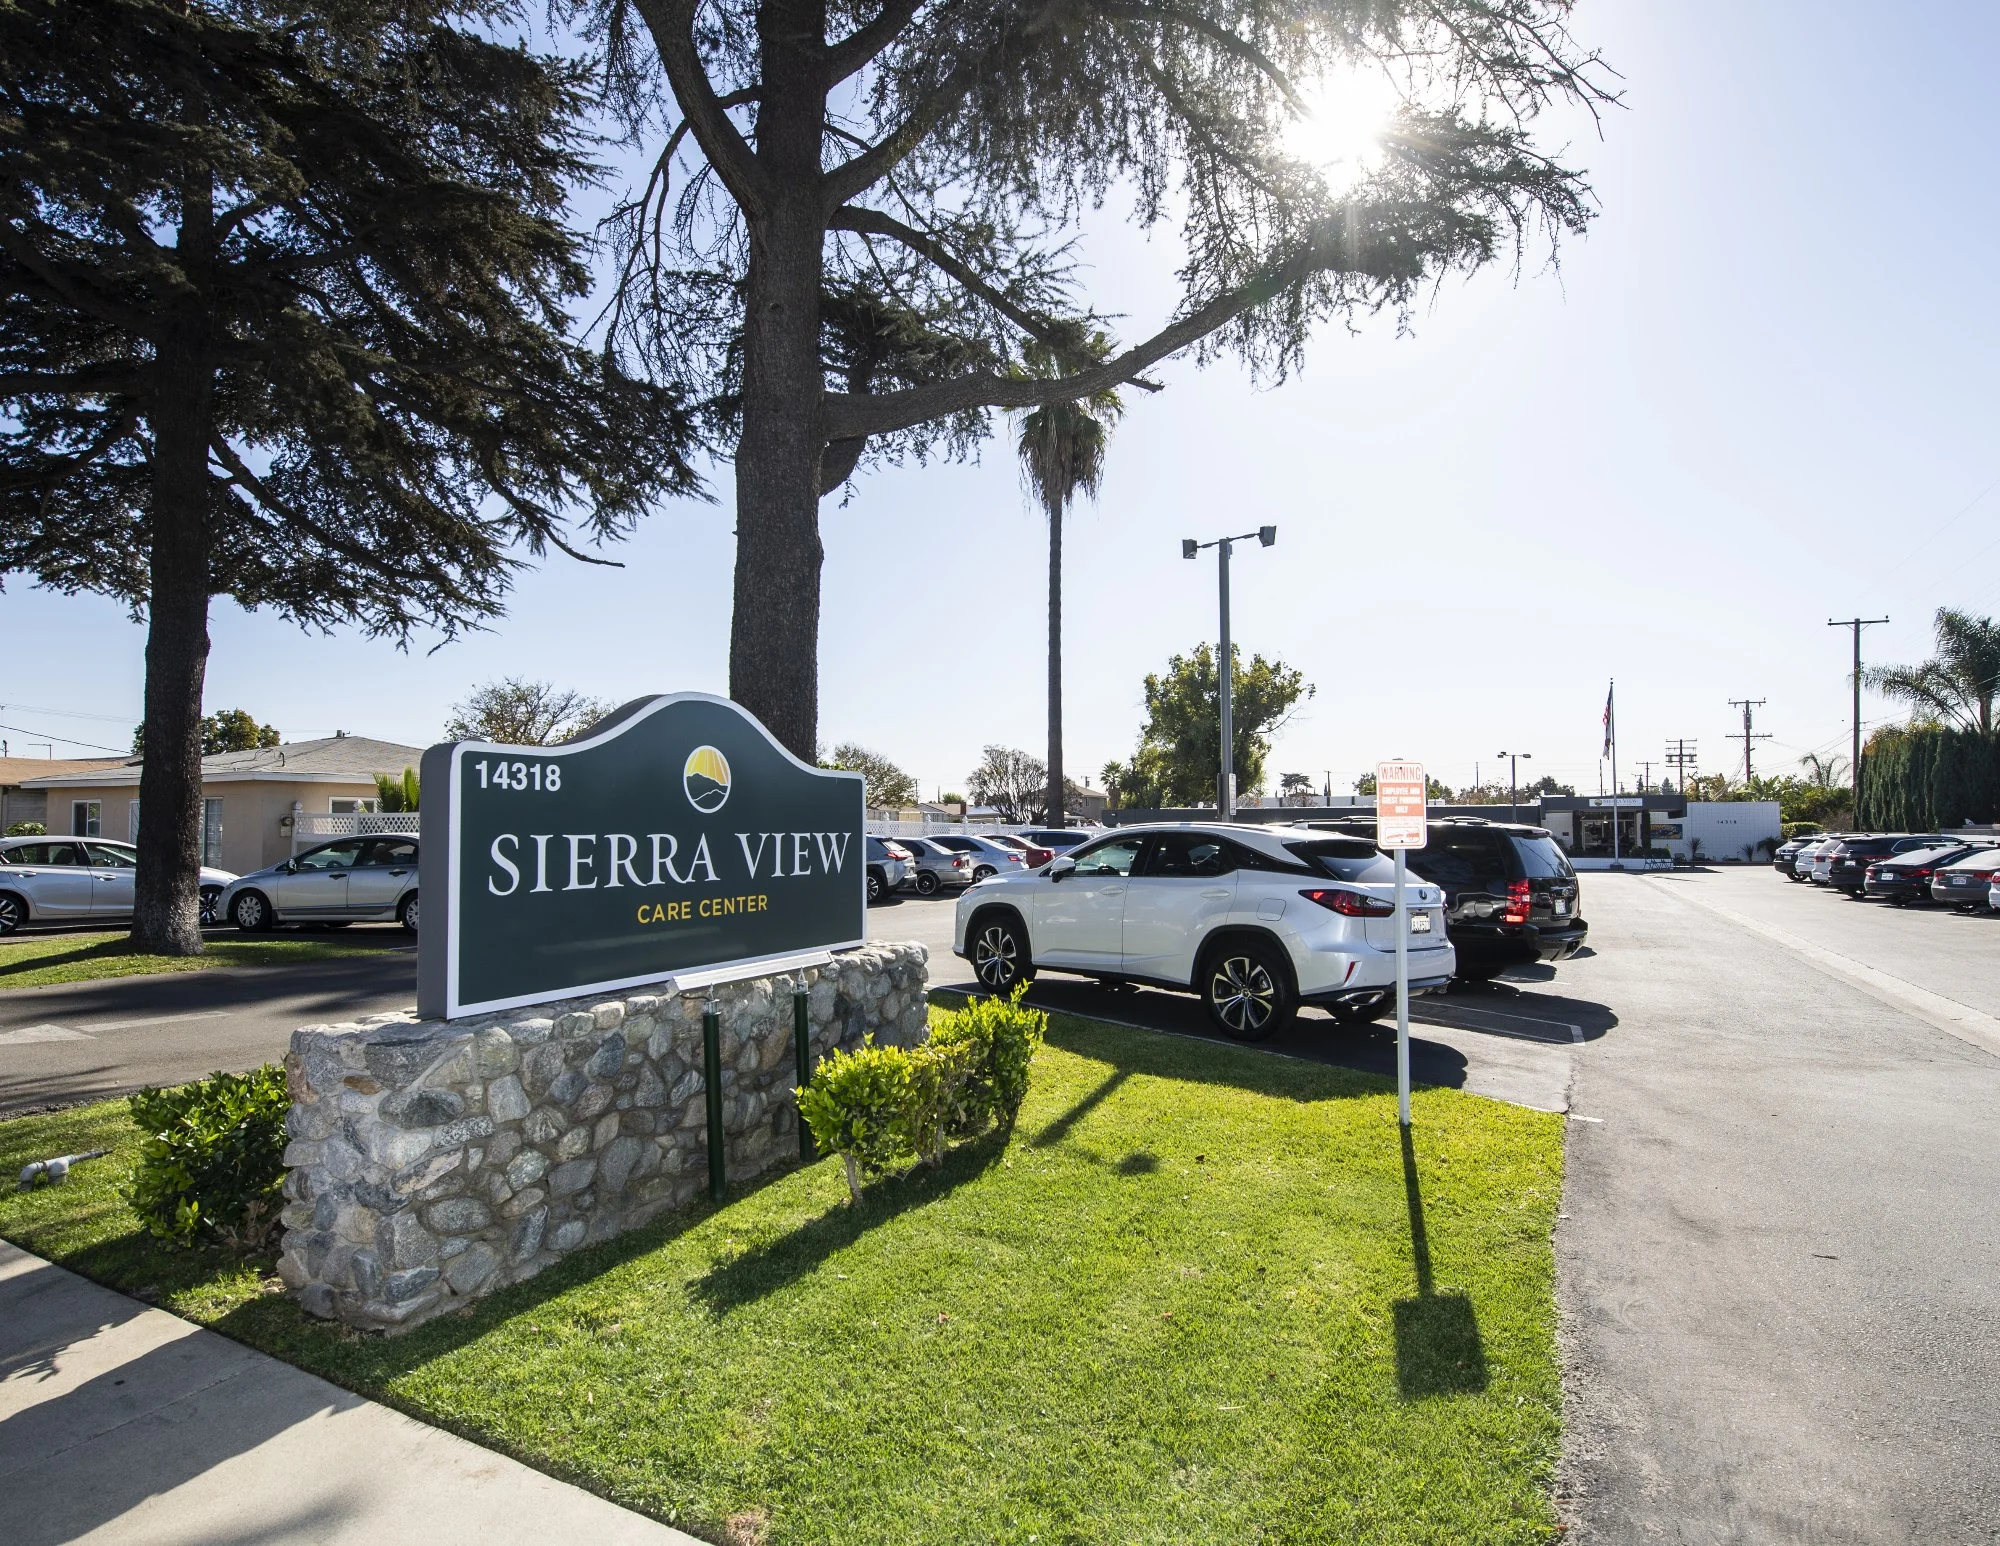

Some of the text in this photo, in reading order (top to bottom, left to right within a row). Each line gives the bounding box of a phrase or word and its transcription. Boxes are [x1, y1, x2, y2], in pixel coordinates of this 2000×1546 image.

[475, 760, 562, 792] 14318
[1381, 766, 1421, 781] WARNING
[1382, 787, 1409, 795] EMPLOYEE
[1382, 796, 1398, 805] GUEST
[1395, 805, 1409, 814] ONLY
[488, 832, 852, 896] SIERRA VIEW
[637, 894, 768, 924] CARE CENTER
